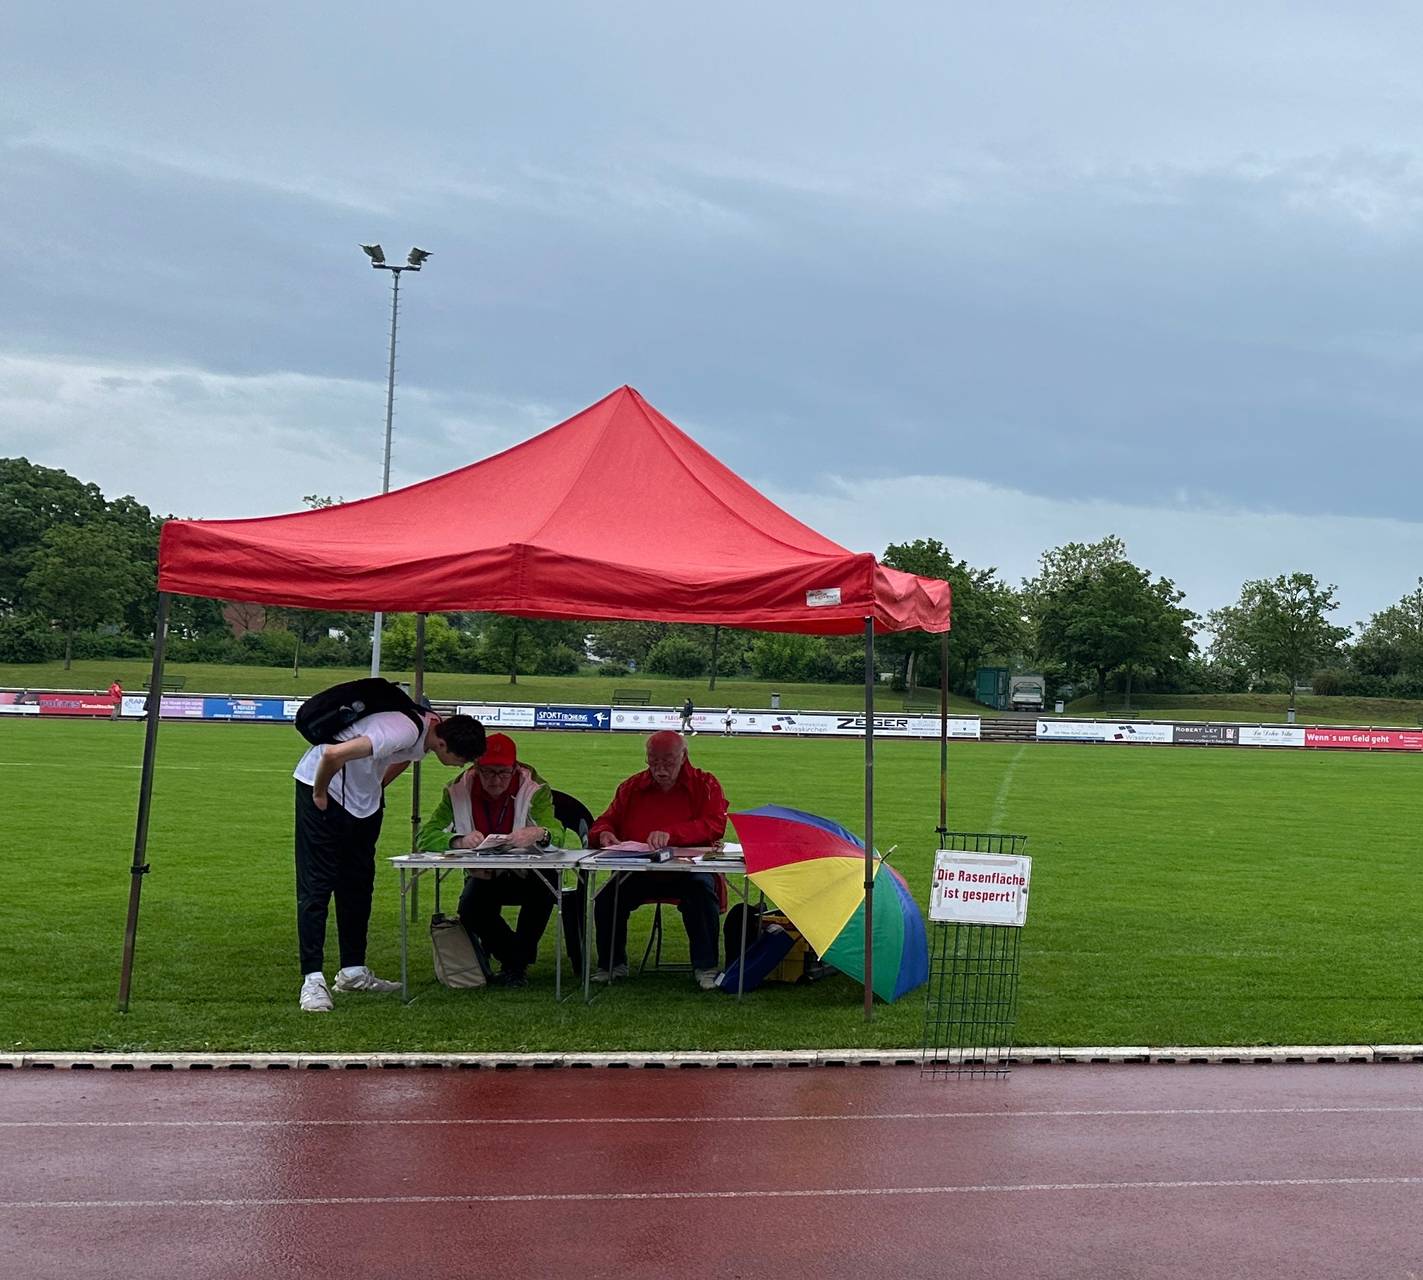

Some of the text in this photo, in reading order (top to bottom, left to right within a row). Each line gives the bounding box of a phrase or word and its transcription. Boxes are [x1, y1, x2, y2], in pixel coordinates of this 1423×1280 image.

[836, 717, 908, 729] ZEGER
[1352, 734, 1370, 743] Geld
[1371, 735, 1390, 745] geht
[937, 868, 1026, 886] Die Rasenfläche
[944, 887, 1015, 903] ist gesperrt!
